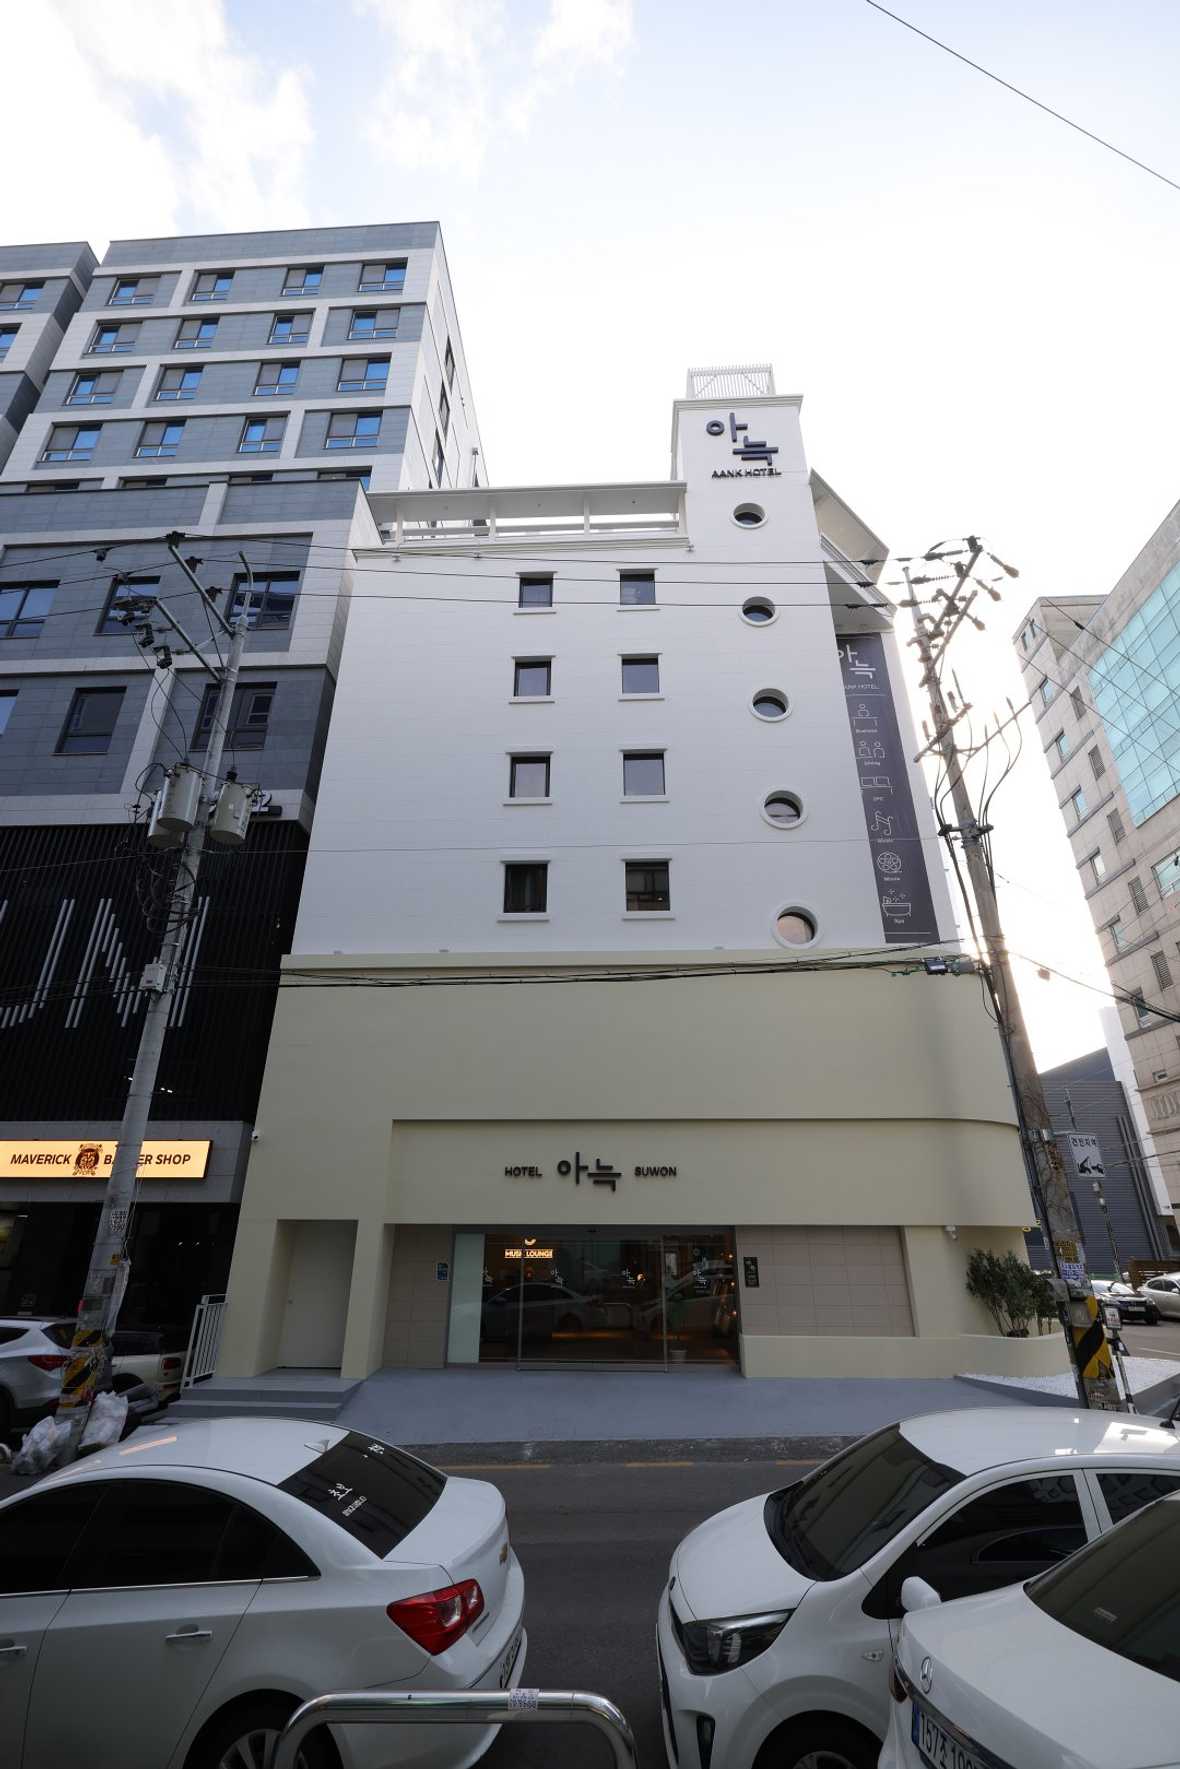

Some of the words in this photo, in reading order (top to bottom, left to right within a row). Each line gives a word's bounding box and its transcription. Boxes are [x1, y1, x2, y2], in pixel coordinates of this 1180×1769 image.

[706, 412, 779, 466] 아늑
[711, 470, 742, 479] AANK
[744, 468, 782, 477] HOTEL
[10, 1153, 72, 1165] MAVERICK
[103, 1153, 153, 1165] BER
[155, 1153, 191, 1165] SHOP
[504, 1166, 542, 1178] HOTEL
[557, 1151, 622, 1192] 아늑
[634, 1166, 677, 1177] SUWON
